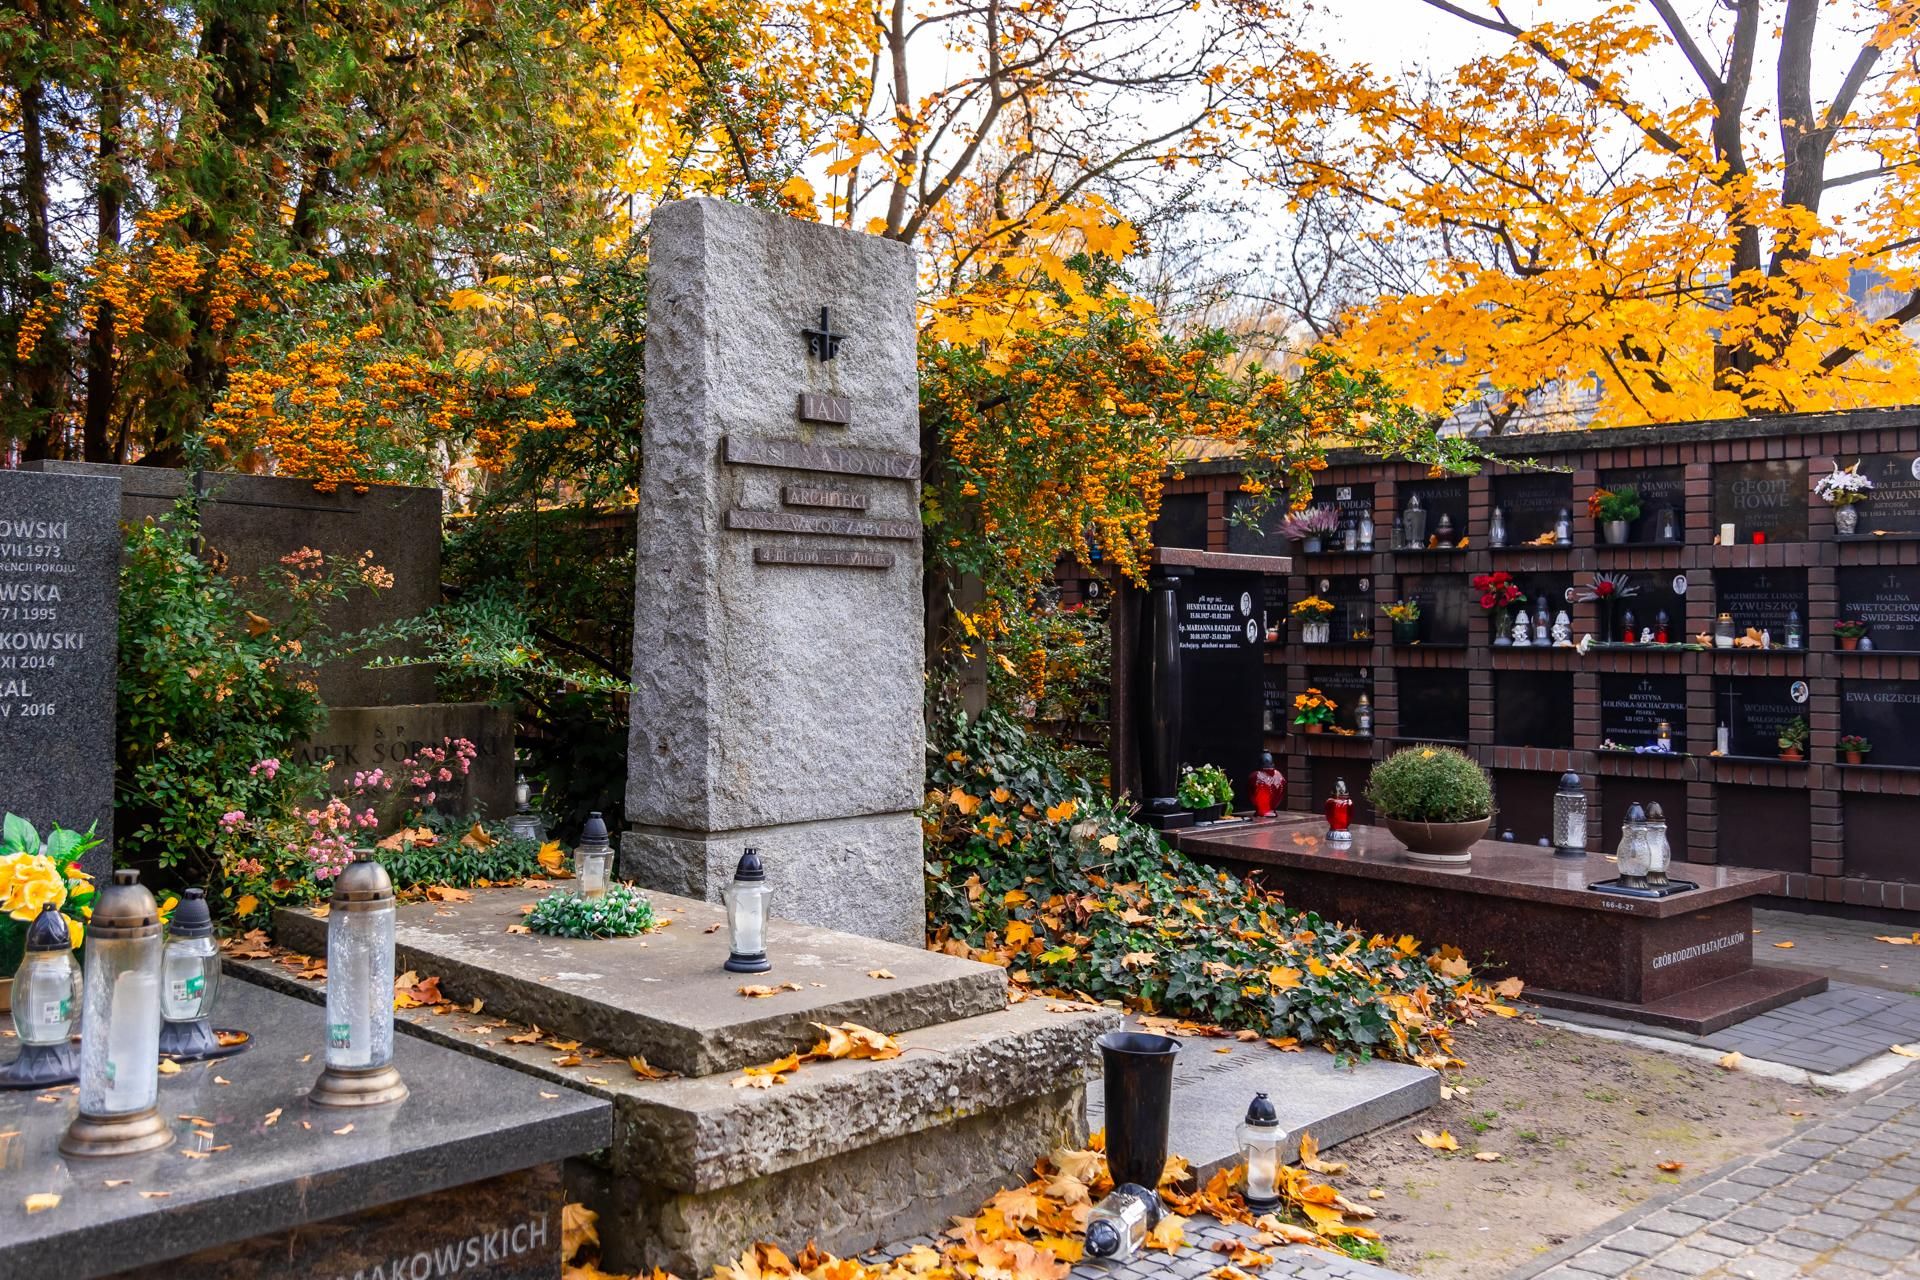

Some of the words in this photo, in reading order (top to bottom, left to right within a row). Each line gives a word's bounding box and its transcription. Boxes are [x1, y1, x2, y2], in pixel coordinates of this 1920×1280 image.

[807, 399, 847, 421] JAN
[1731, 480, 1792, 495] GEOFF
[791, 490, 868, 509] ARCHITEKT
[1733, 494, 1790, 509] HOWE
[26, 544, 61, 558] 1973
[35, 562, 77, 573] POKOJU
[22, 607, 57, 620] 1995
[1186, 603, 1207, 611] HENRYK
[1207, 604, 1235, 612] RATAJCZAK
[1186, 623, 1215, 631] MARIANNA
[1215, 625, 1242, 633] RATAJCZAK
[20, 656, 56, 669] 2014
[1629, 693, 1662, 701] KRYSTYNA
[1846, 691, 1871, 702] EWA
[20, 703, 56, 716] 2016
[290, 743, 360, 768] AREK
[1652, 951, 1672, 969] GRÓB
[1672, 944, 1701, 964] RODZINY
[1701, 931, 1745, 953] RATAJCZAKÓW
